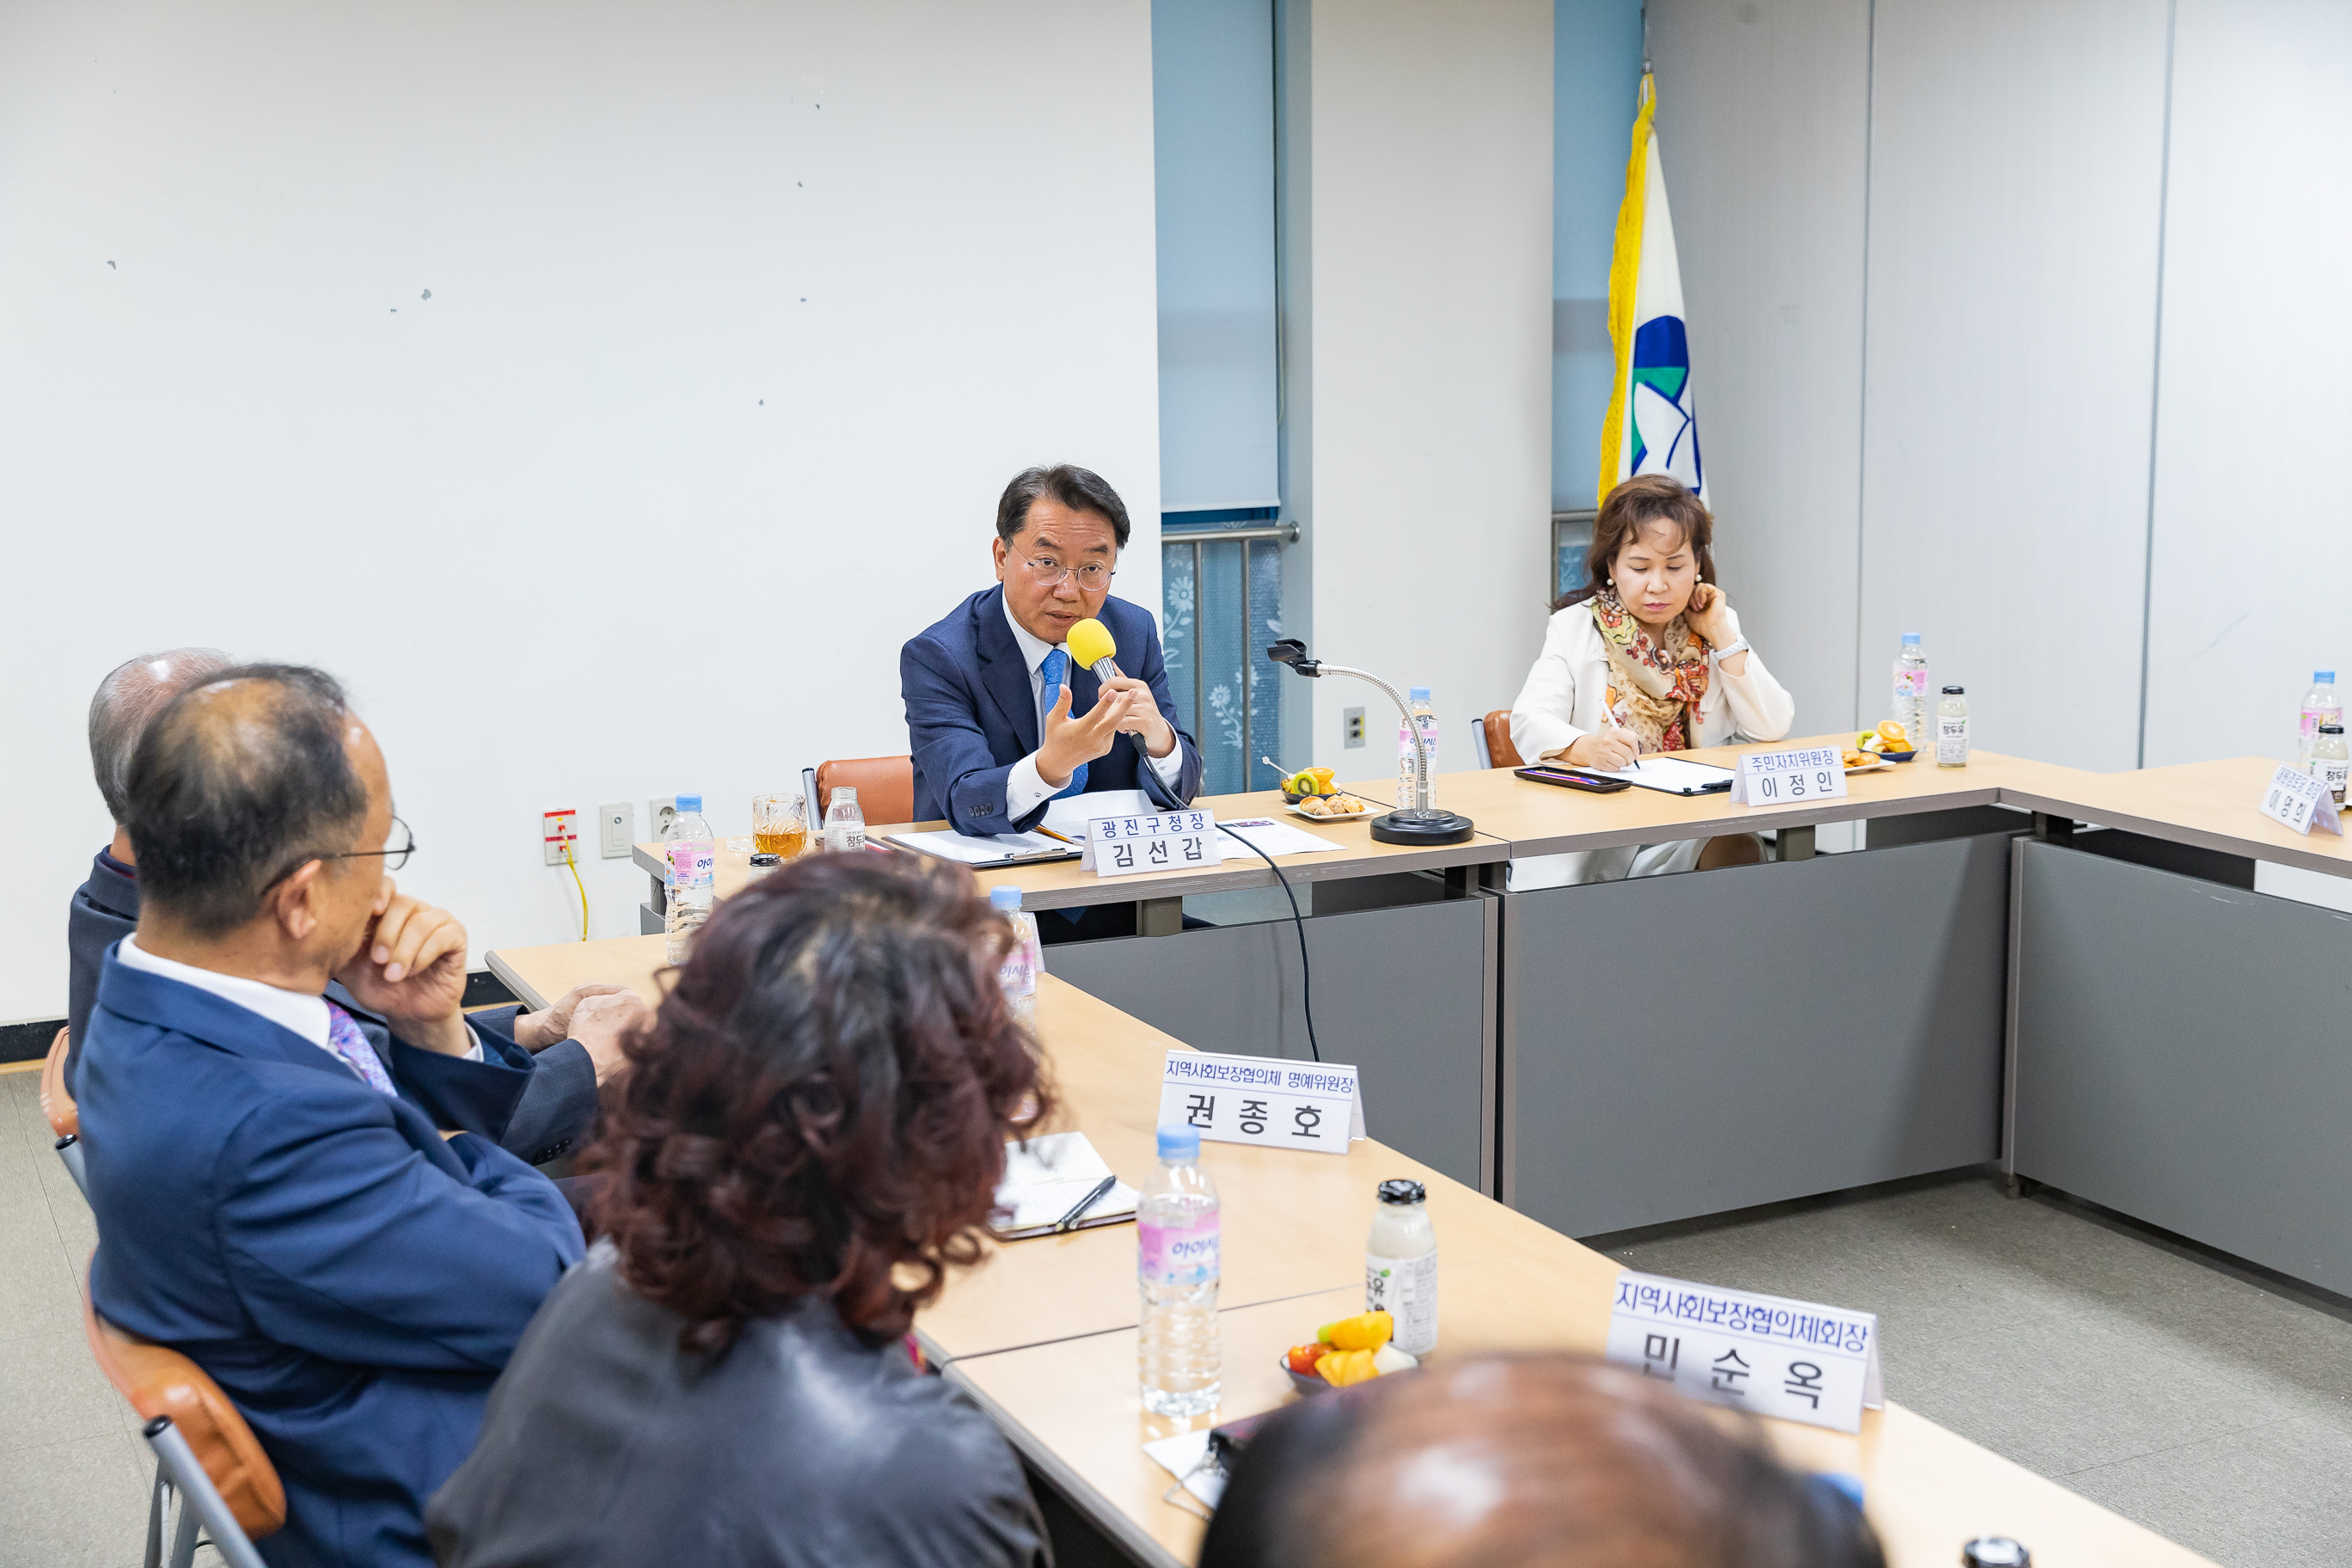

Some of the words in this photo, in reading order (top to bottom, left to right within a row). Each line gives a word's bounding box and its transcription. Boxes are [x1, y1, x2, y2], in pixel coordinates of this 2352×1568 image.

[1751, 750, 1834, 772] 주민자치위원장
[1761, 771, 1833, 798] 이정인
[1101, 812, 1204, 838] 광진구청장
[1112, 836, 1203, 868] 김선갑
[1166, 1060, 1282, 1086] 지역사회보장협의체
[1288, 1072, 1354, 1093] 명예위원장
[1186, 1093, 1322, 1138] 권종호
[1615, 1282, 1867, 1352] 지역사회보장협의체회장
[1642, 1333, 1822, 1409] 민순옥
